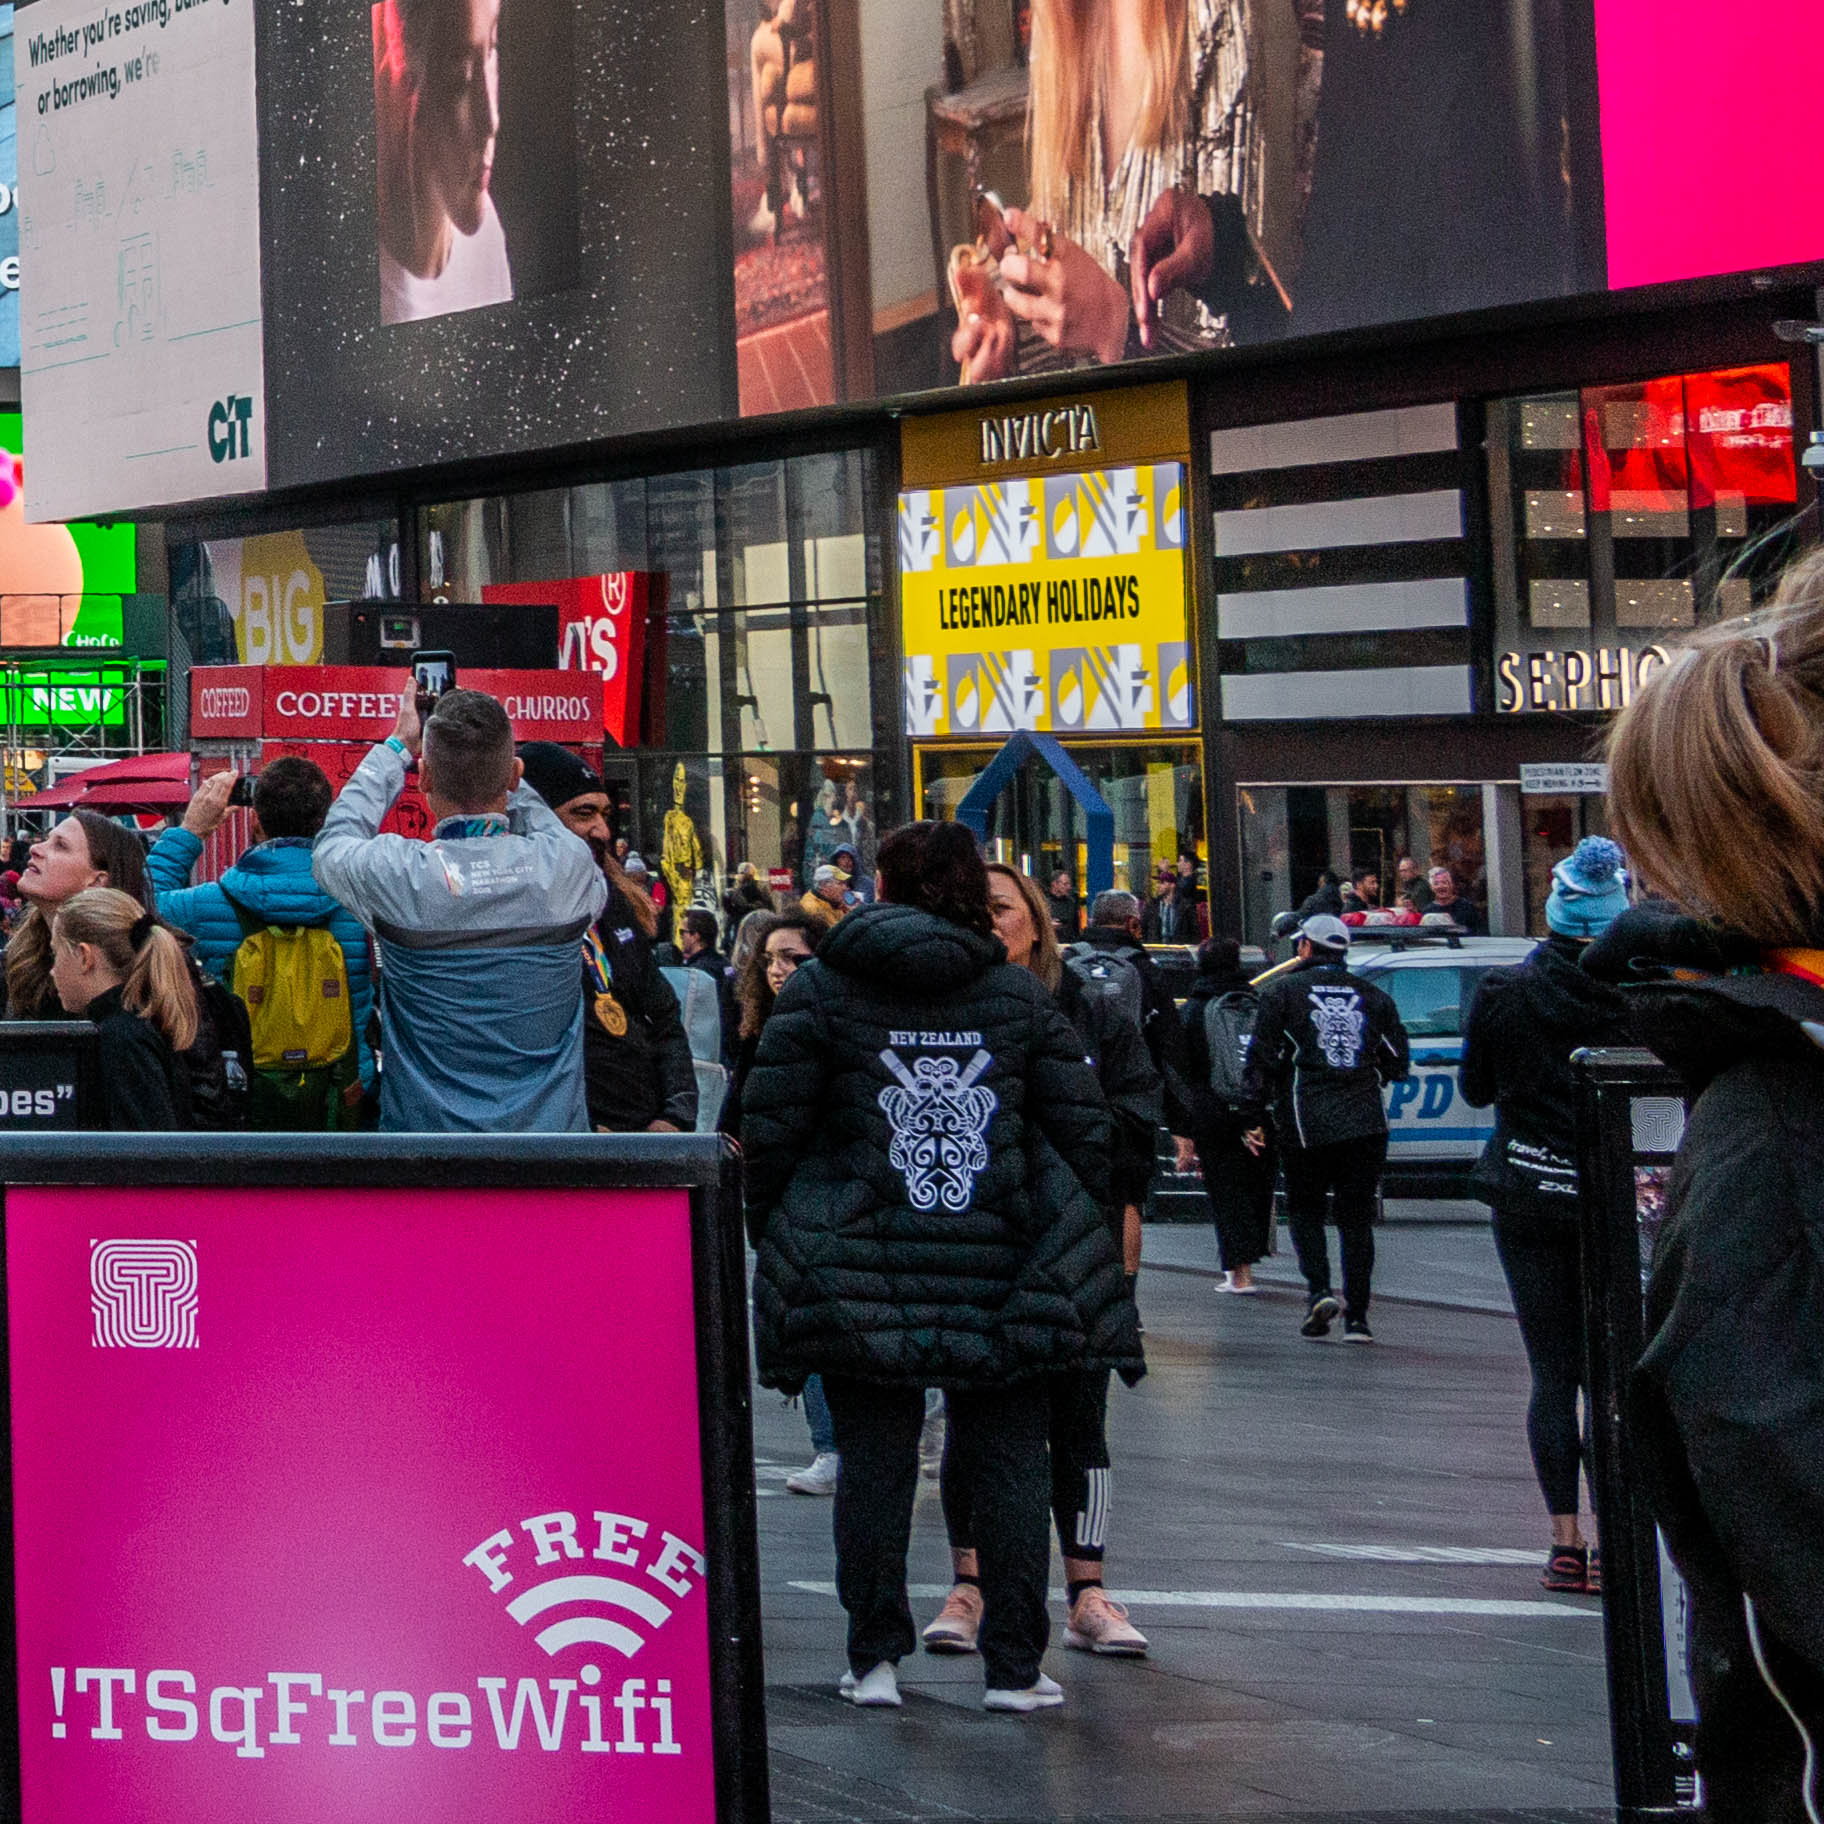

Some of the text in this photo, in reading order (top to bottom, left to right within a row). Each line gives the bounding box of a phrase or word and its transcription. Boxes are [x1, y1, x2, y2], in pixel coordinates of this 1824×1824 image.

[27, 23, 79, 67] Whether
[82, 8, 122, 50] you're
[37, 63, 121, 116] or borrowing,
[979, 405, 1102, 464] INVICTA
[244, 573, 315, 666] BIG
[937, 573, 1141, 631] LEGENDARY HOLIDAYS
[33, 687, 112, 712] NEW
[200, 685, 250, 720] COFFEED
[504, 695, 592, 721] CHURROS
[889, 1030, 982, 1047] NEW ZEALAND
[461, 1509, 707, 1598] FREE
[49, 1663, 683, 1759] !TSqFreeWifi
